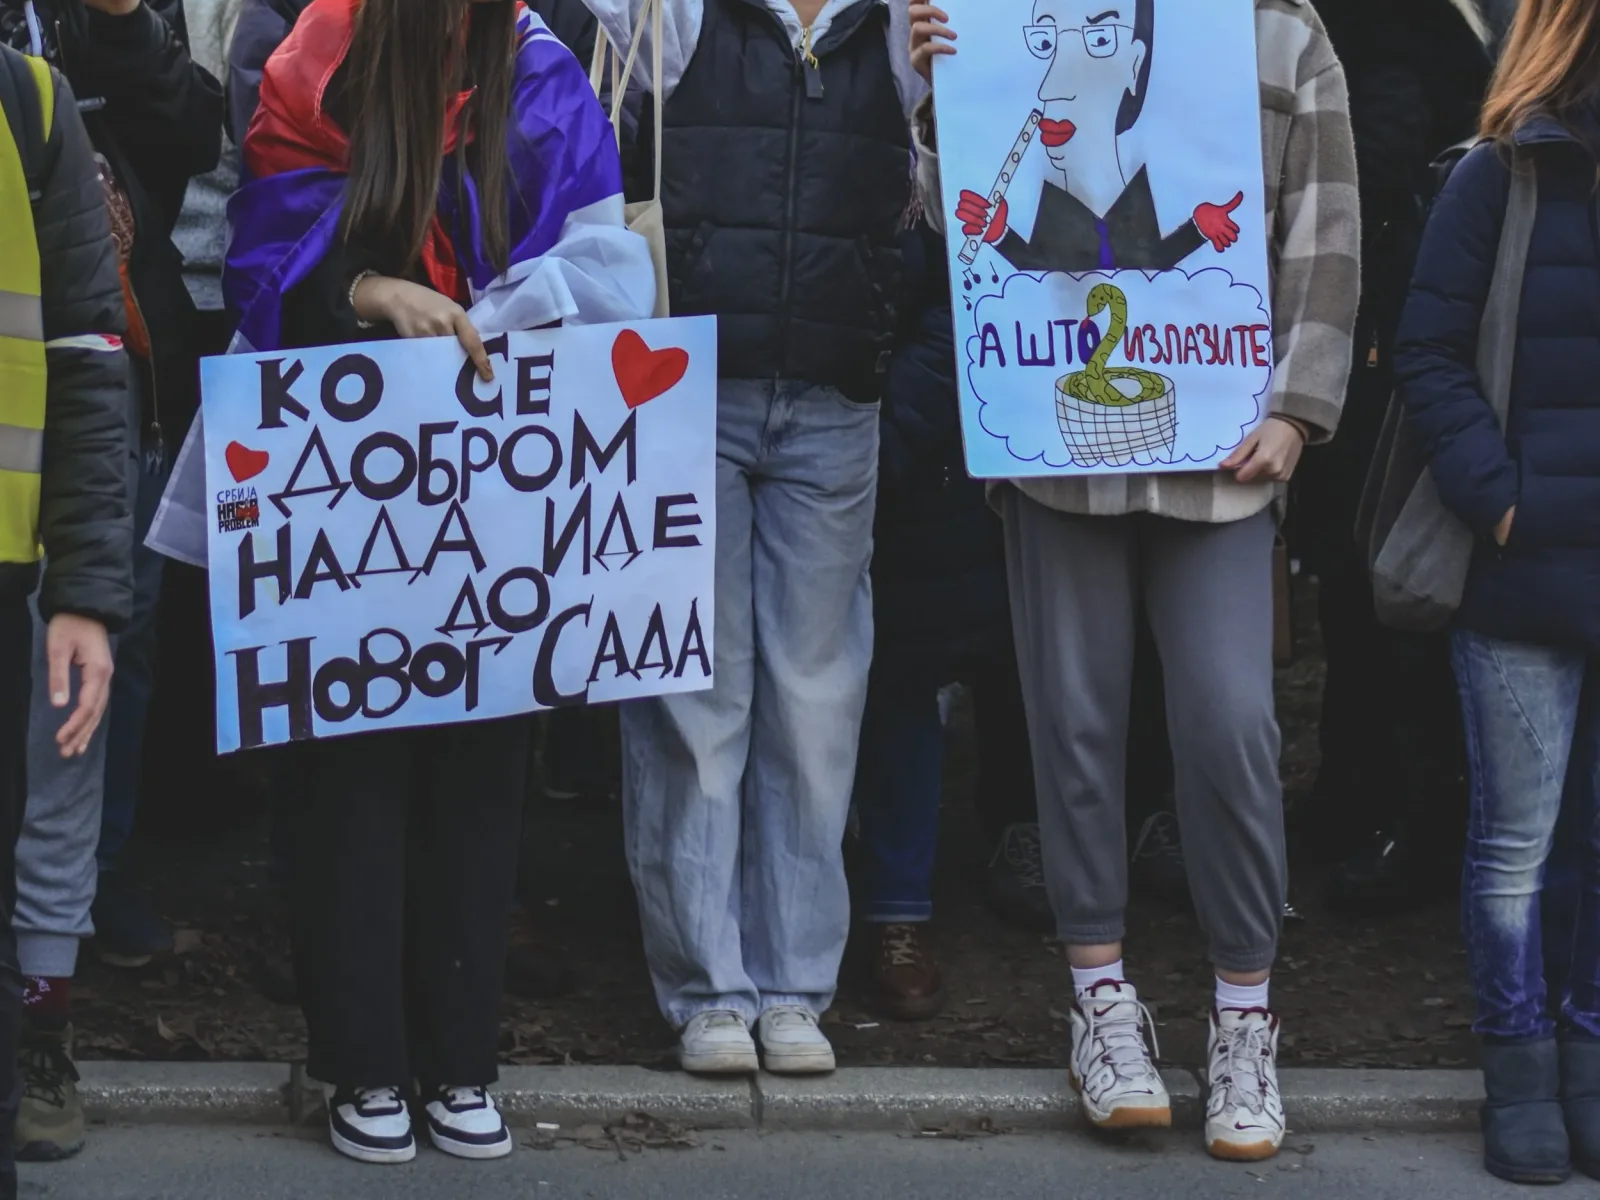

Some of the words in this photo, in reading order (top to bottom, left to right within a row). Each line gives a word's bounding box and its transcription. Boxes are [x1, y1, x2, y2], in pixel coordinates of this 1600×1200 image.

[255, 353, 384, 430] КО
[455, 332, 555, 420] СЕ
[980, 322, 1006, 368] А
[1015, 319, 1101, 367] ШТО
[1124, 323, 1270, 368] ИЗЛАЗИТЕ
[216, 486, 257, 504] СРБИЈА
[267, 407, 637, 518] ДОБРОМ
[238, 499, 487, 619] НАДА
[542, 483, 703, 577] ИДЕ
[435, 566, 551, 637] ДО
[533, 595, 712, 707] САДА
